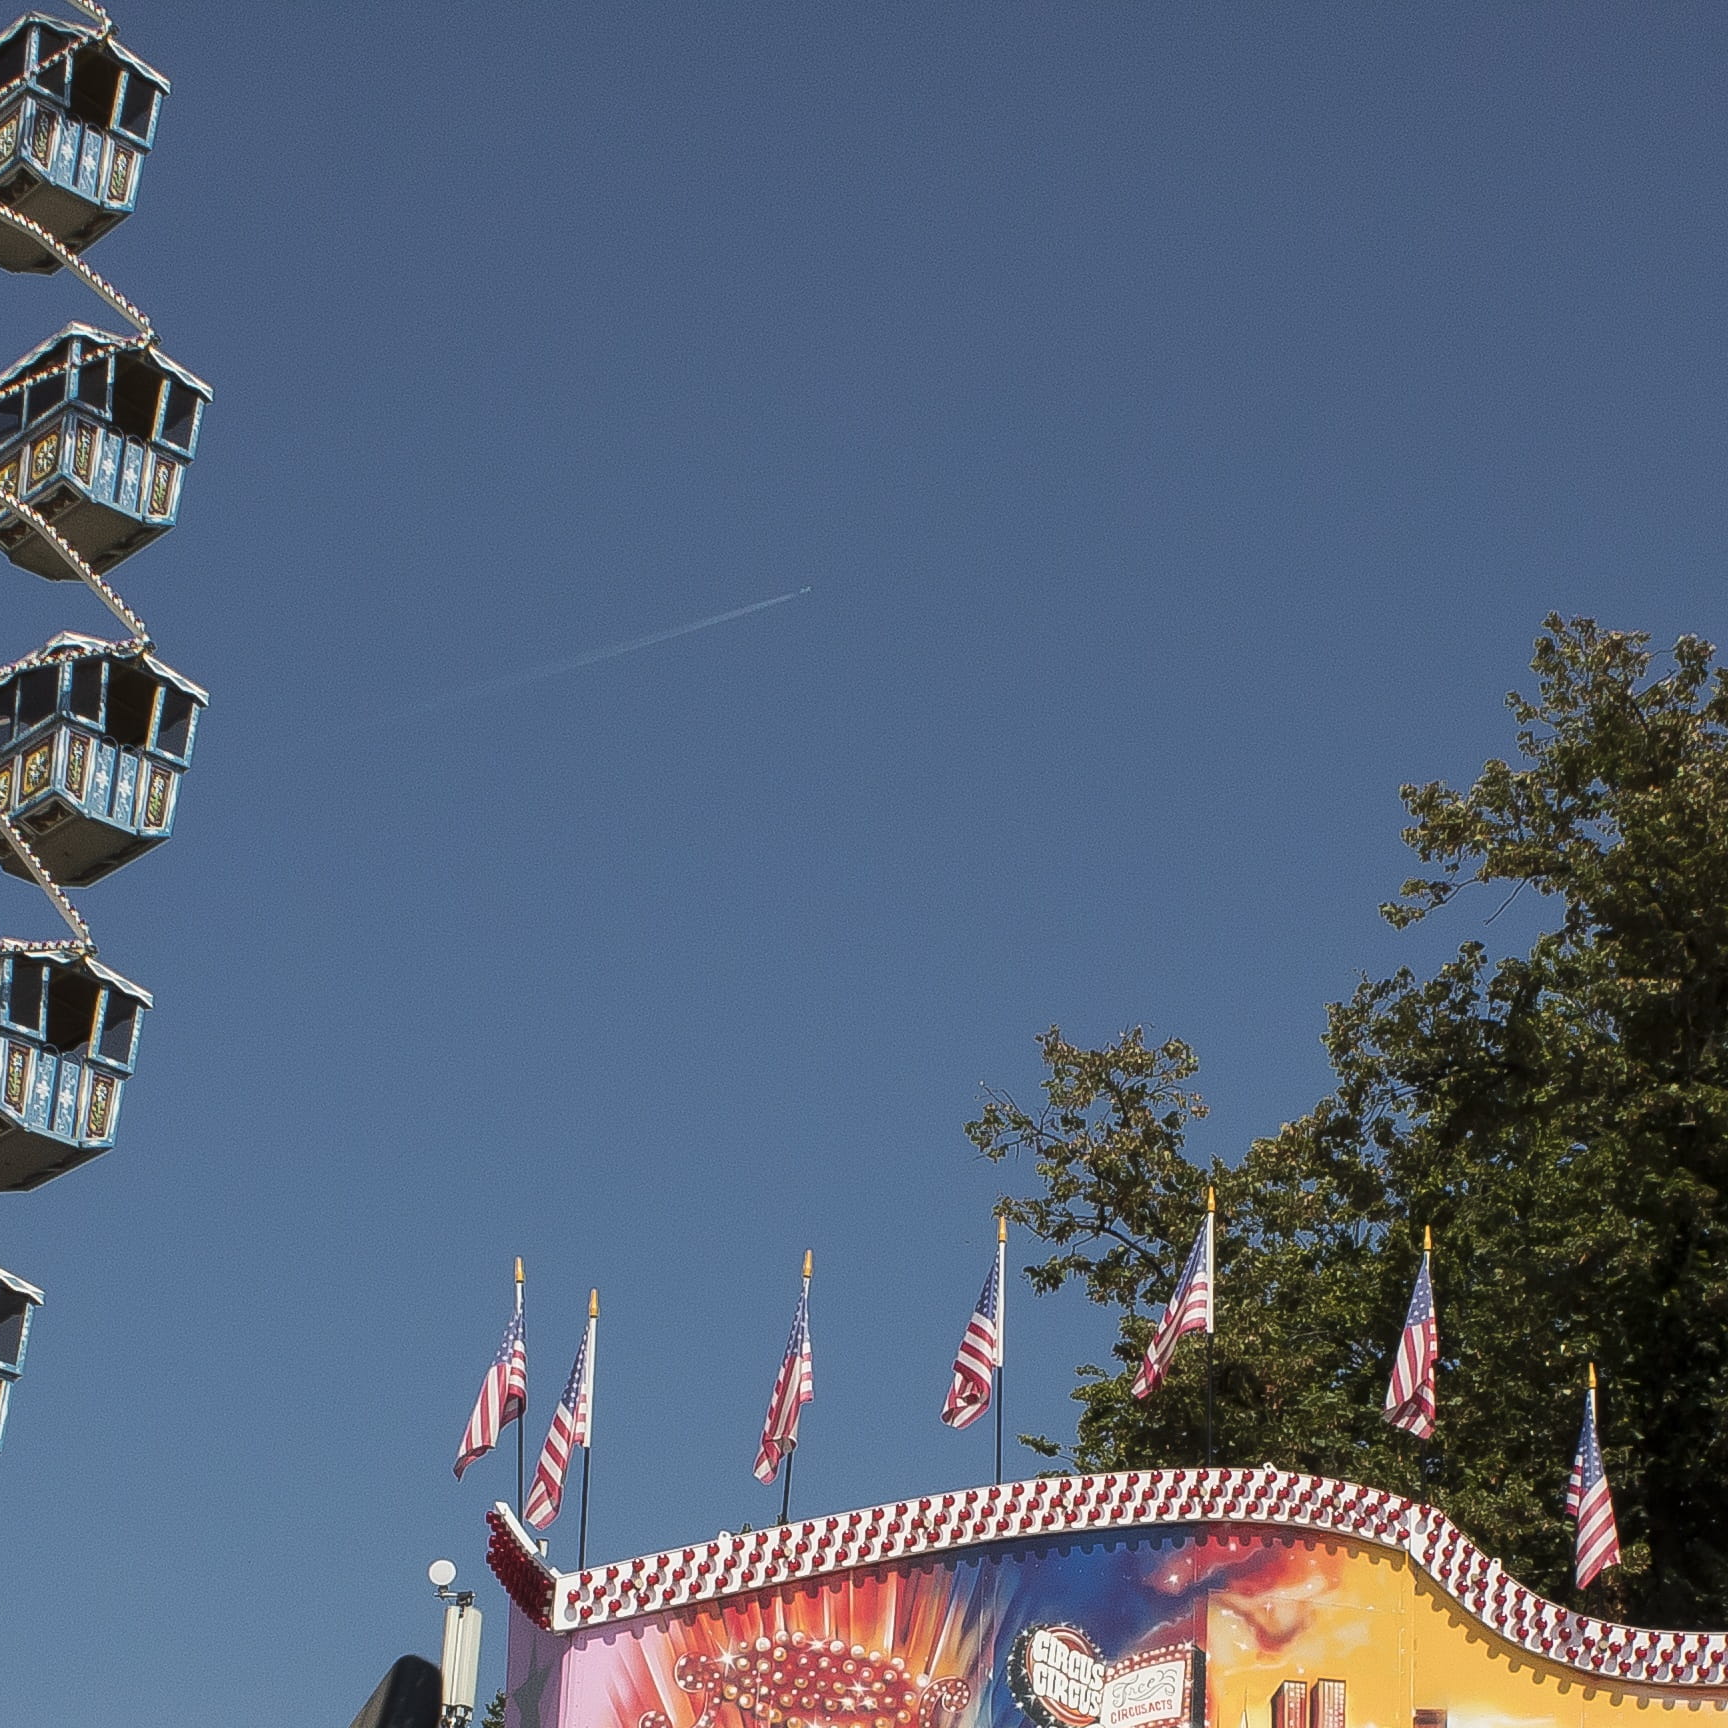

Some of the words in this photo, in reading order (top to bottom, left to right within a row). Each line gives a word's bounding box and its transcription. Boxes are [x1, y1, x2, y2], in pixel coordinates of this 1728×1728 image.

[1032, 1629, 1106, 1691] CIRCUS
[1032, 1662, 1103, 1717] CIRCUS
[1112, 1669, 1176, 1708] Free
